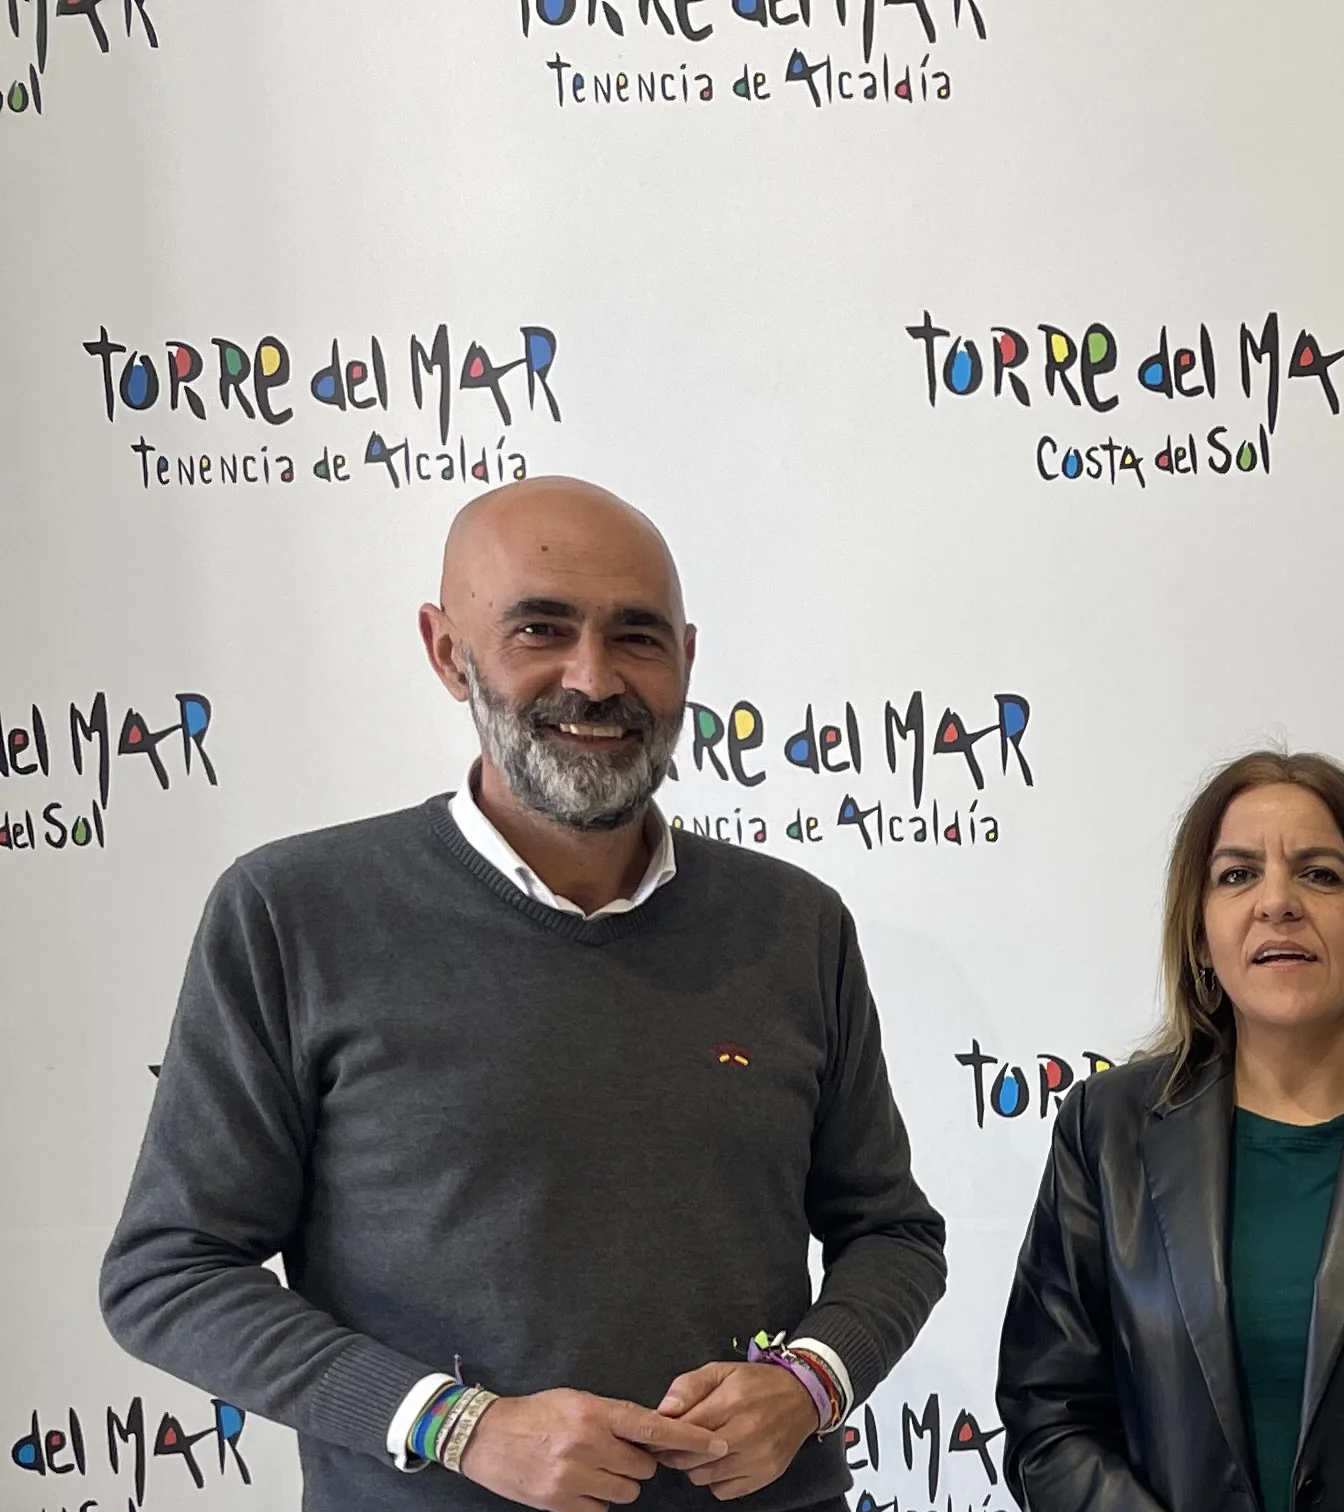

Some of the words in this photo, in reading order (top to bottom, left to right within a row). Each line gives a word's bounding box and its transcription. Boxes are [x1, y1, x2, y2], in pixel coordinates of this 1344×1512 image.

[733, 64, 770, 100] de
[311, 336, 387, 411] del
[411, 324, 561, 449] MAR
[1138, 324, 1215, 399] del
[314, 447, 350, 482] de
[1155, 434, 1197, 474] del
[1207, 424, 1269, 474] Sol
[70, 692, 217, 810] MAR
[784, 702, 861, 774] del
[885, 691, 1033, 812] MAR
[786, 809, 822, 843] de
[12, 1408, 85, 1476] del
[104, 1396, 254, 1508] MAR
